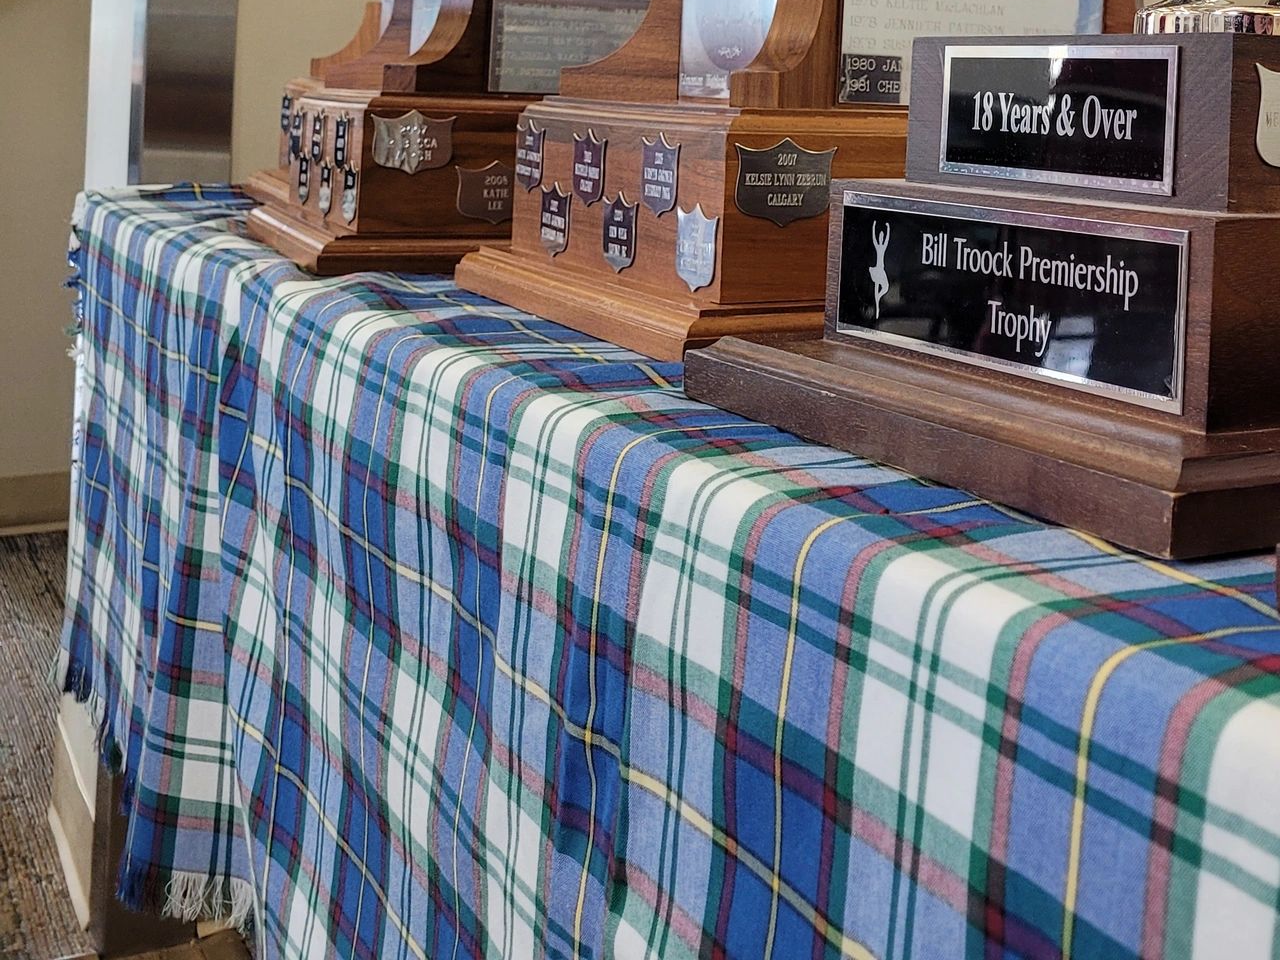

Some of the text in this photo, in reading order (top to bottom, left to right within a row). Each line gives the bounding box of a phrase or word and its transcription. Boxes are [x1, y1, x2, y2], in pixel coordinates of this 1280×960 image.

[848, 57, 877, 71] 1980
[971, 90, 1138, 141] 18 Years & Over
[777, 153, 799, 166] 2007
[744, 172, 773, 187] KELSIE
[773, 172, 795, 187] LYNN
[767, 192, 804, 207] CALGARY
[921, 232, 1140, 312] Bill Troock Premiership
[987, 299, 1053, 359] Trophy
